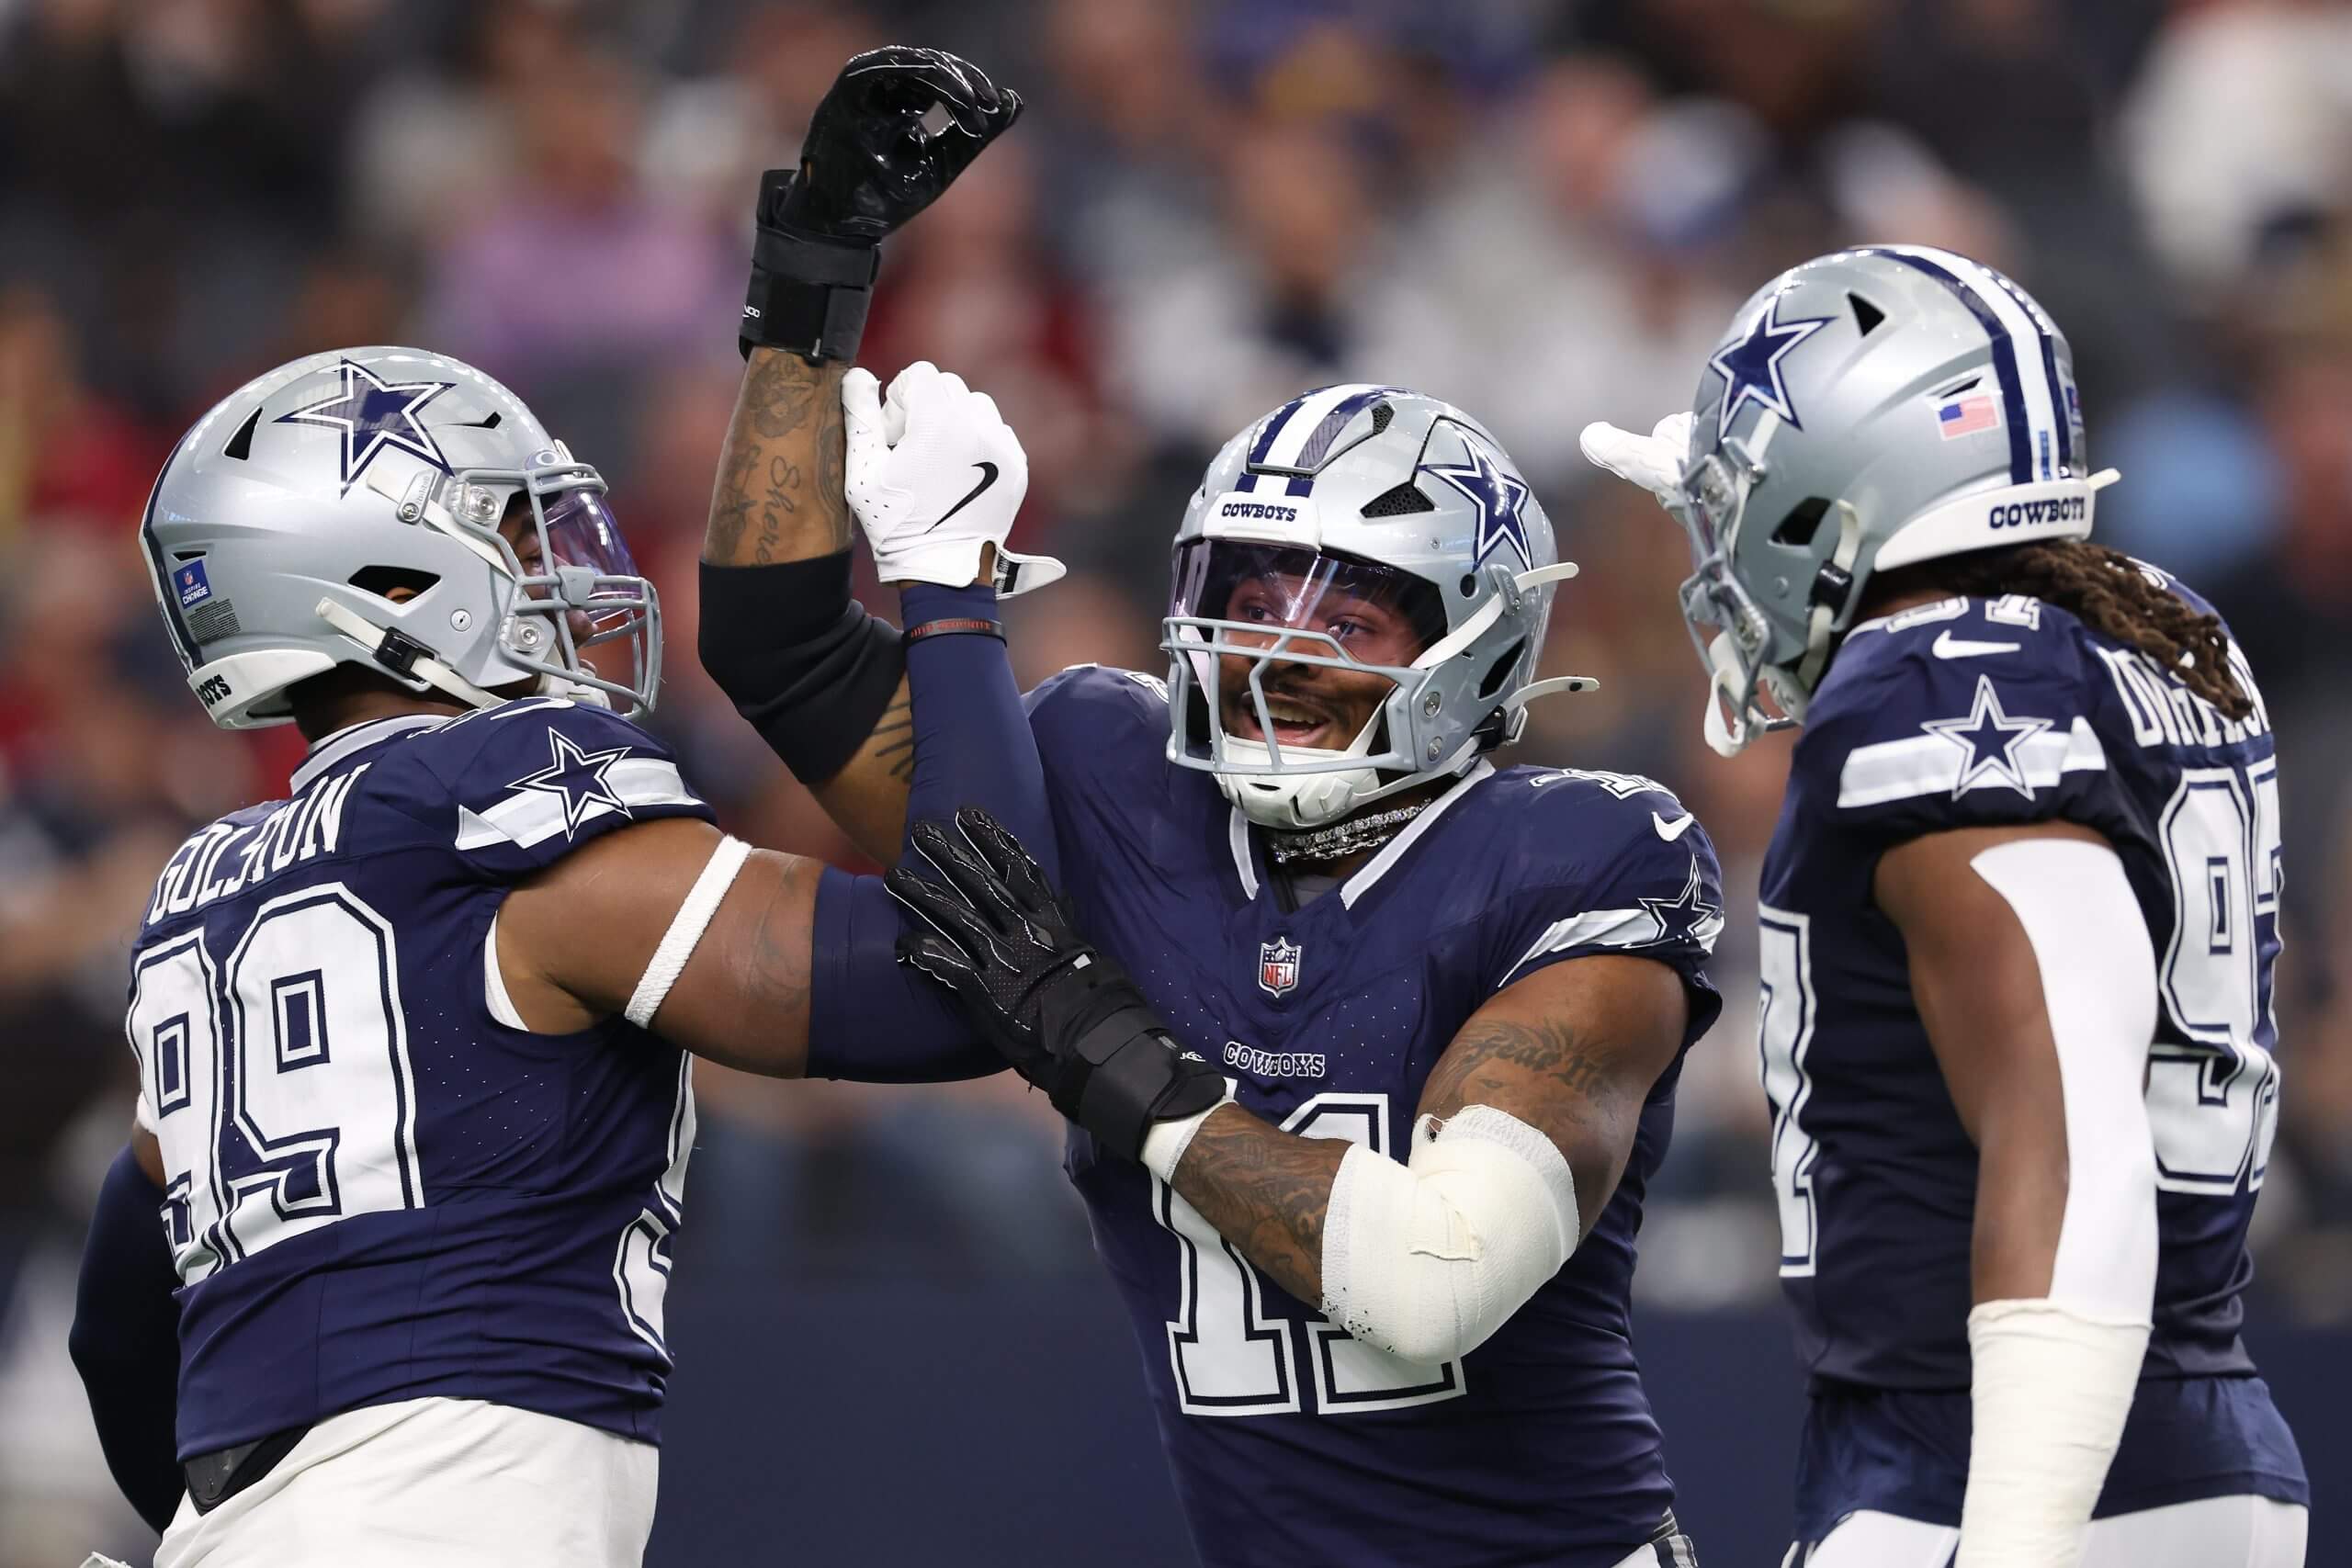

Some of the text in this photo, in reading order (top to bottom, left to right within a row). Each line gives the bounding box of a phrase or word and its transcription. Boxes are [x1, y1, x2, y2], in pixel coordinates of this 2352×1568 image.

[1221, 502, 1297, 523] COWBOYS
[1263, 964, 1294, 986] NFL
[125, 881, 426, 1288] 99
